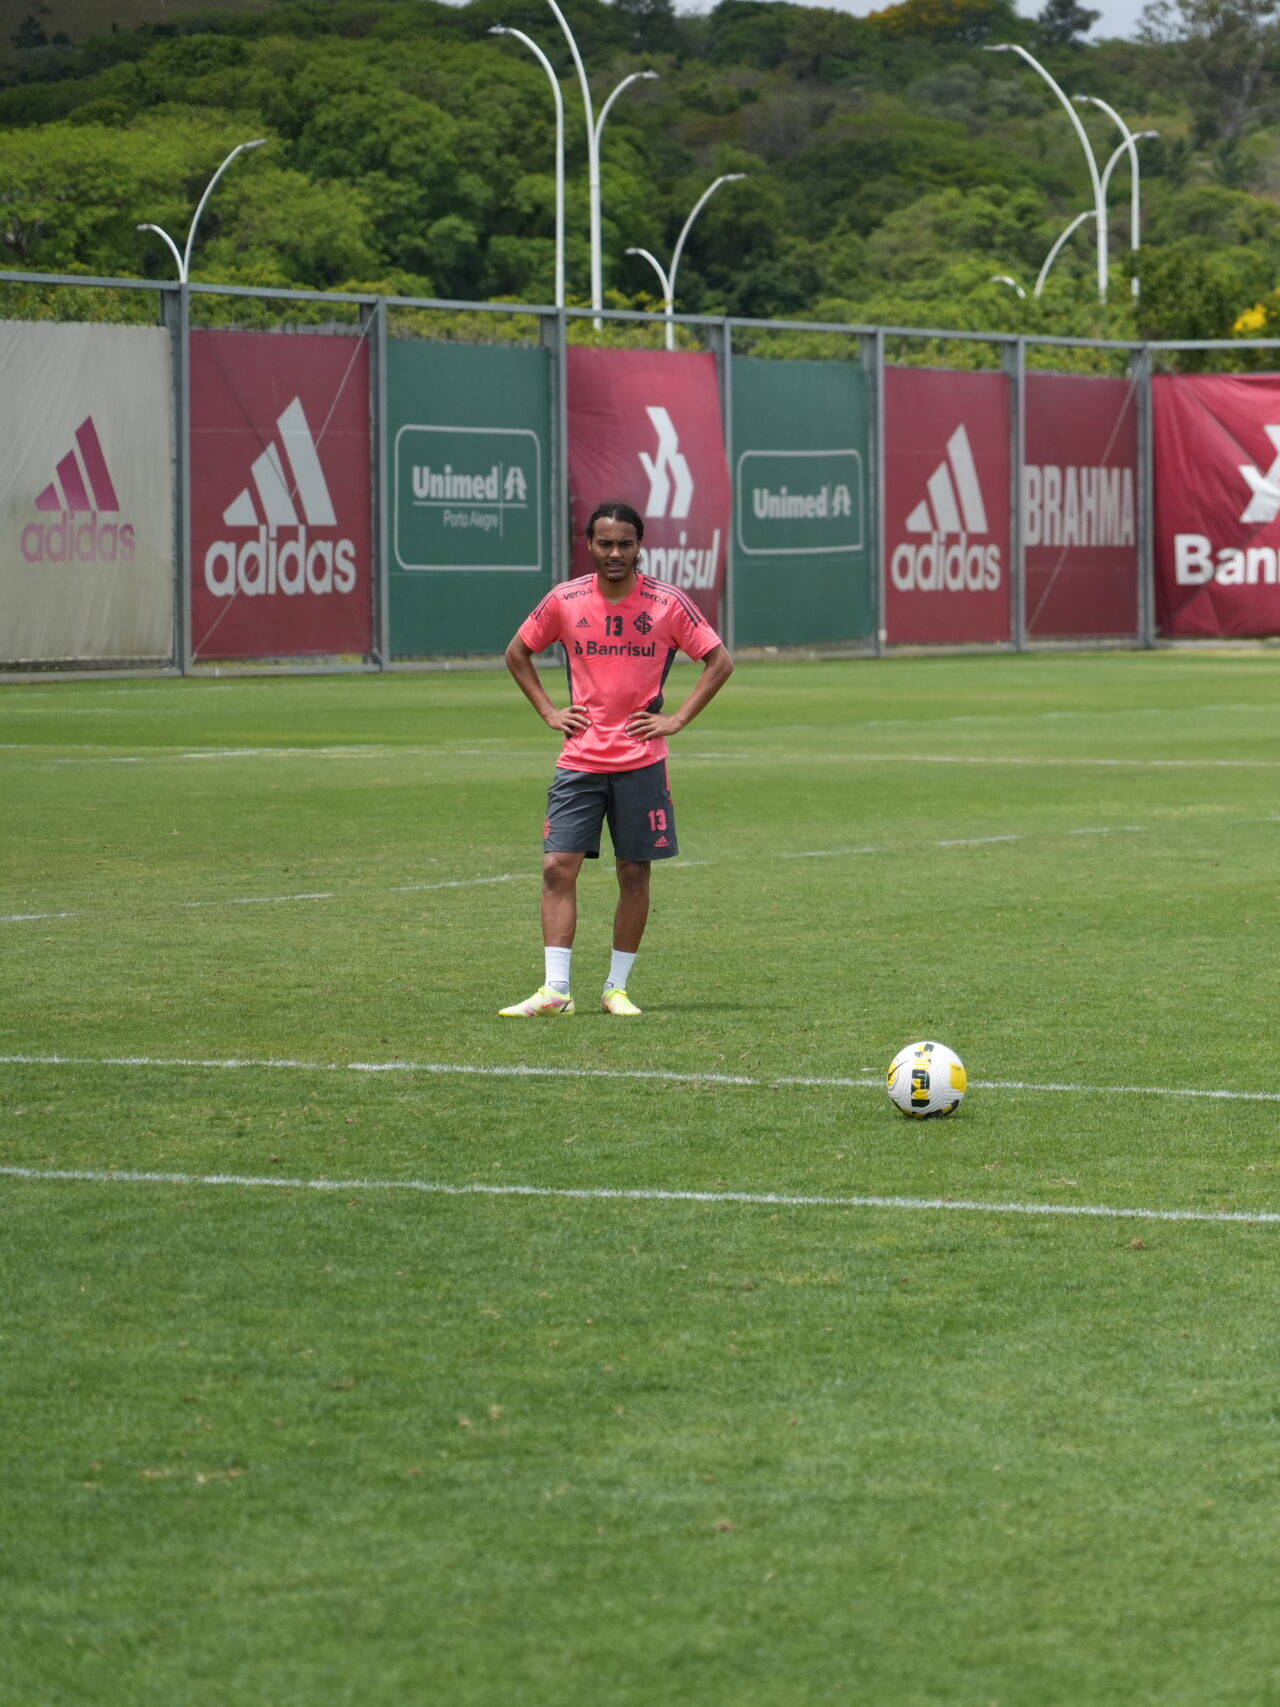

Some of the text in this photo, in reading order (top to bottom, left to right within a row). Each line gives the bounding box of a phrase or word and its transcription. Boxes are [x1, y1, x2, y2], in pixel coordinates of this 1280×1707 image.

[412, 465, 498, 499] Unimed
[752, 486, 828, 519] Unimed
[1023, 465, 1136, 547] BRAHMA
[20, 511, 136, 562] adidas
[443, 509, 498, 531] Porto Alegre
[204, 524, 356, 597] adidas
[637, 528, 720, 591] anrisul
[891, 531, 1002, 592] adidas
[605, 615, 623, 637] 13
[586, 641, 656, 657] Banrisul
[648, 808, 667, 832] 13
